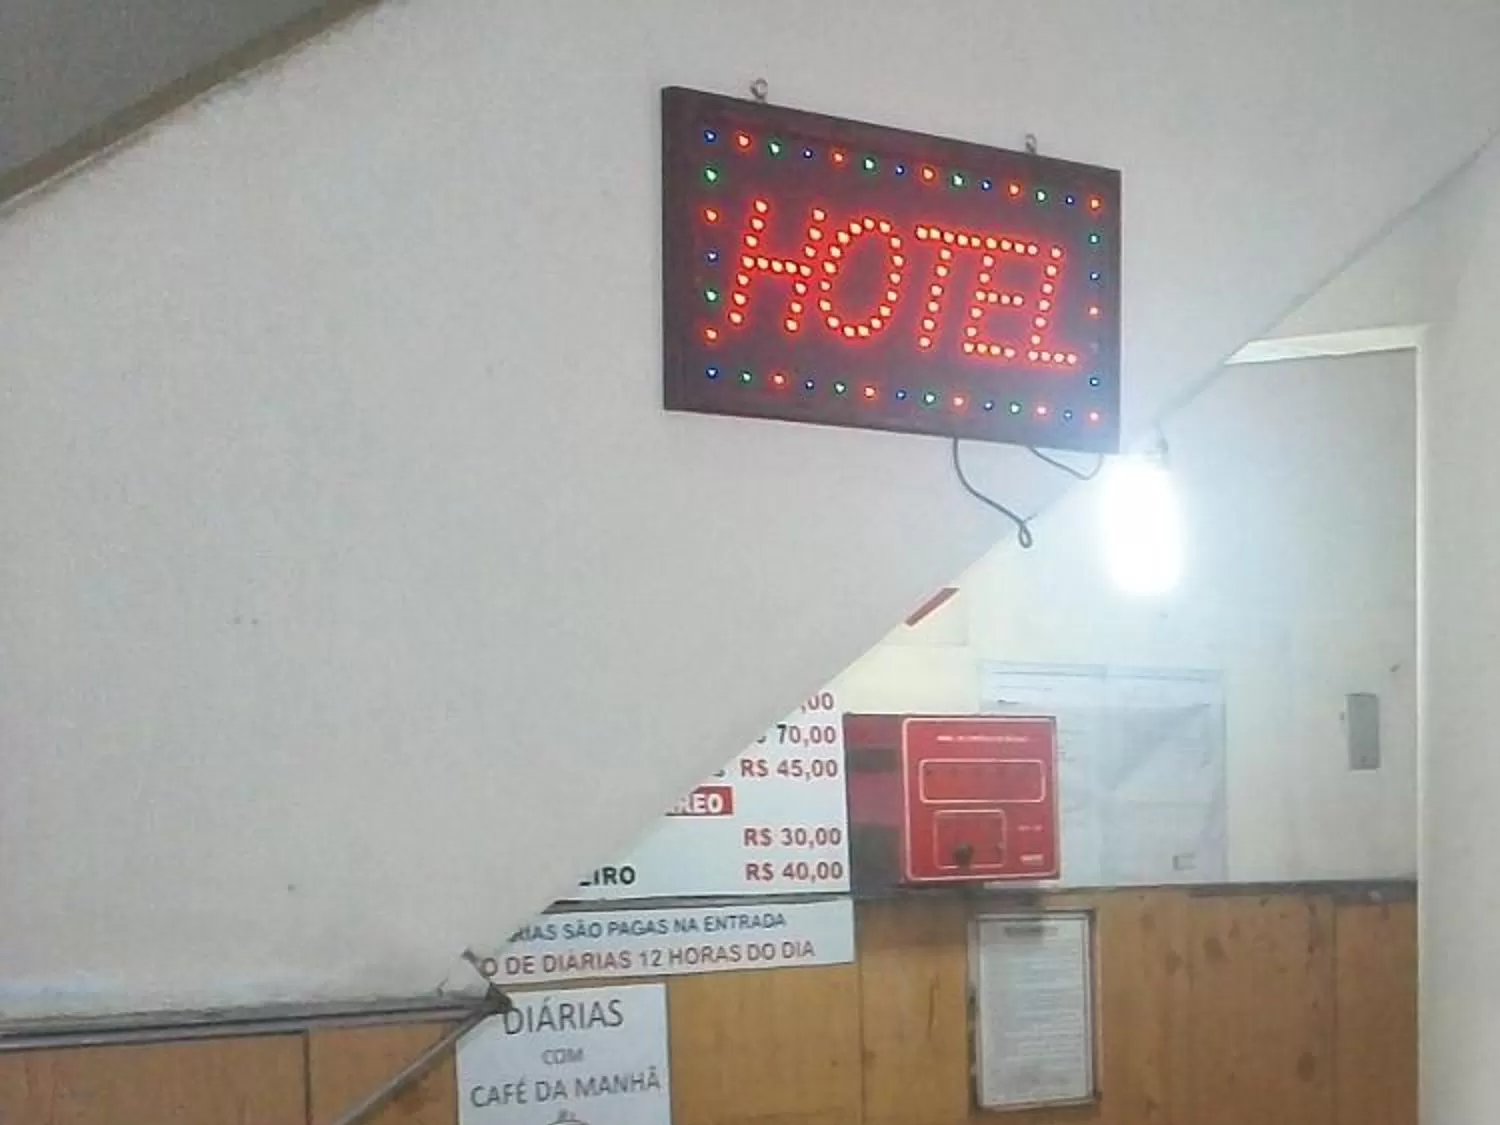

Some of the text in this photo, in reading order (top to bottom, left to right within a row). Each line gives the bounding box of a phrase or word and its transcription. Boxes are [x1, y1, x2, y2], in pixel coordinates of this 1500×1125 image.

[728, 197, 1077, 364] HOTEL
[776, 724, 836, 747] 70,00
[776, 758, 838, 781] 45,00
[780, 827, 842, 849] 30,00
[579, 866, 636, 886] IRO
[782, 861, 843, 884] 40,00
[562, 918, 602, 939] SÃO
[607, 919, 669, 937] PAGAS
[674, 917, 699, 934] NA
[703, 912, 787, 933] ENTRADA
[505, 956, 536, 975] DE
[543, 948, 633, 973] DIÁRIAS
[640, 950, 662, 967] 12
[669, 944, 742, 965] HORAS
[747, 943, 776, 961] DO
[781, 940, 816, 959] DIA
[504, 996, 624, 1035] DIÁRIAS
[542, 1048, 584, 1065] COM
[470, 1065, 661, 1108] CAFÉ DA MANHÃ
